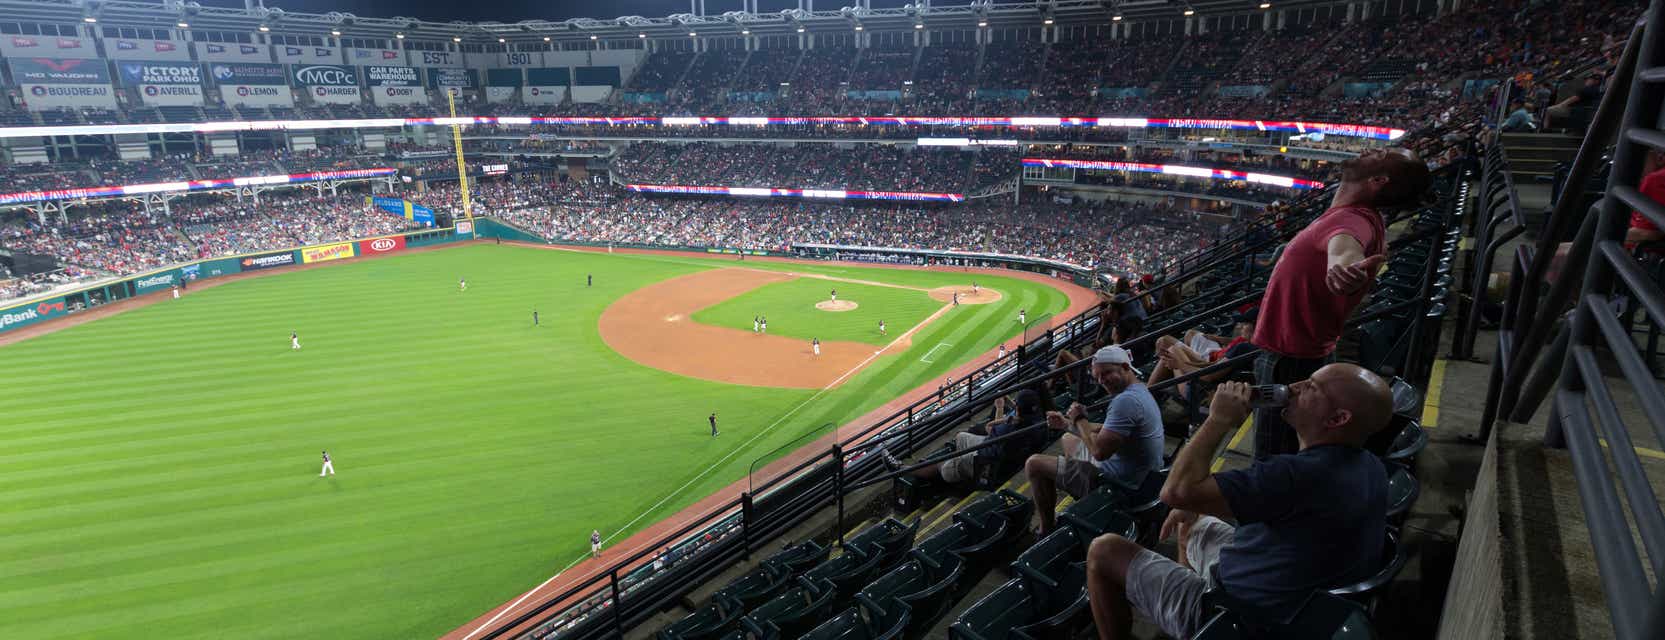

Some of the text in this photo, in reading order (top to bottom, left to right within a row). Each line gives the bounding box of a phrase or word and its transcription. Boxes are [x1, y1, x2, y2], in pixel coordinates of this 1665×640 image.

[48, 88, 107, 96] BOUDREAU
[160, 87, 199, 96] AVERILL
[249, 88, 278, 96] LEMON
